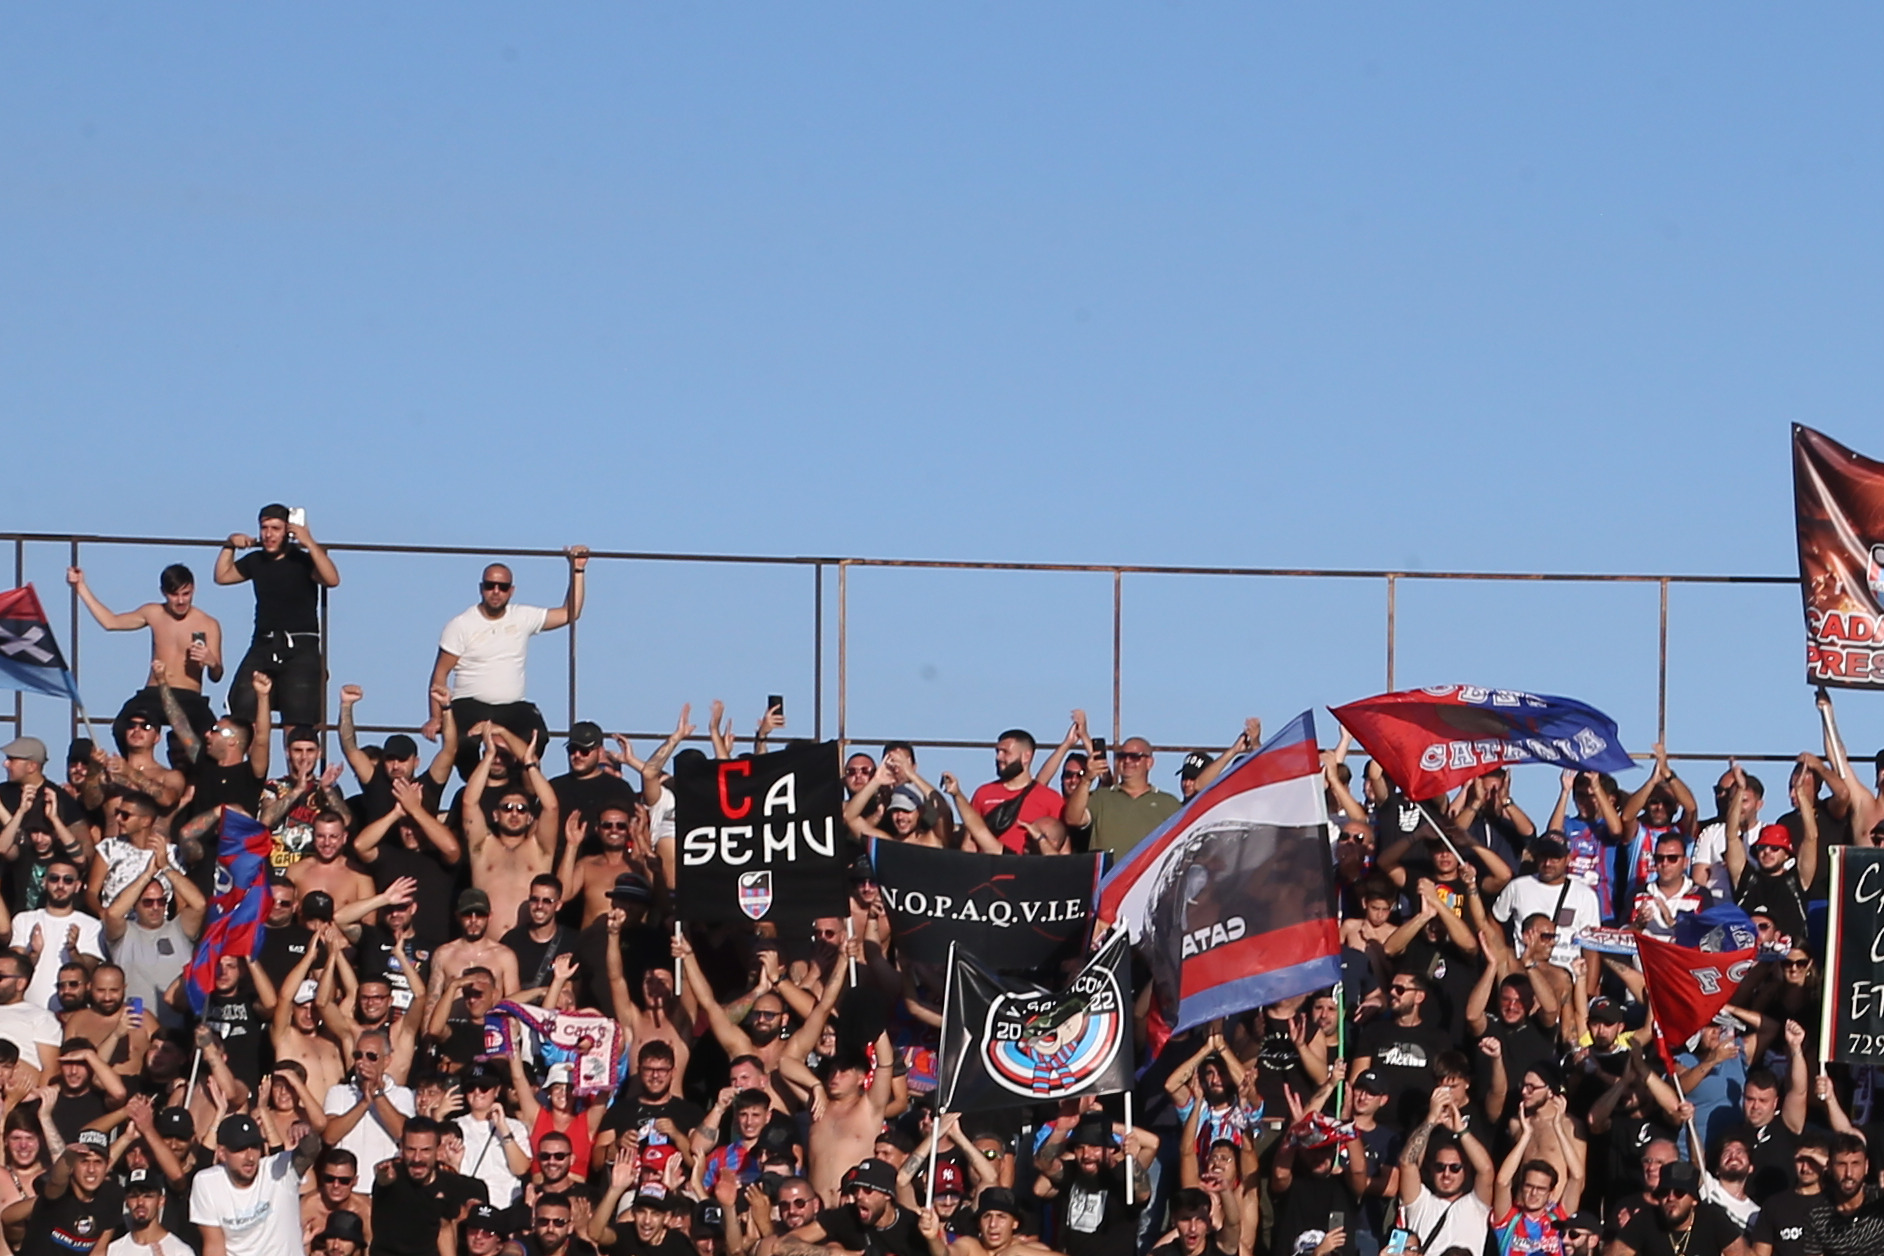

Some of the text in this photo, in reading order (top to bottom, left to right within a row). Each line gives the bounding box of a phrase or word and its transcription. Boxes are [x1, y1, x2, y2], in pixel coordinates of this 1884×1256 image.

[1420, 727, 1607, 771] CATANIA
[880, 885, 1086, 928] N.O.P.A.Q.V.I.E.
[1090, 992, 1115, 1011] 22
[996, 1022, 1021, 1040] 20
